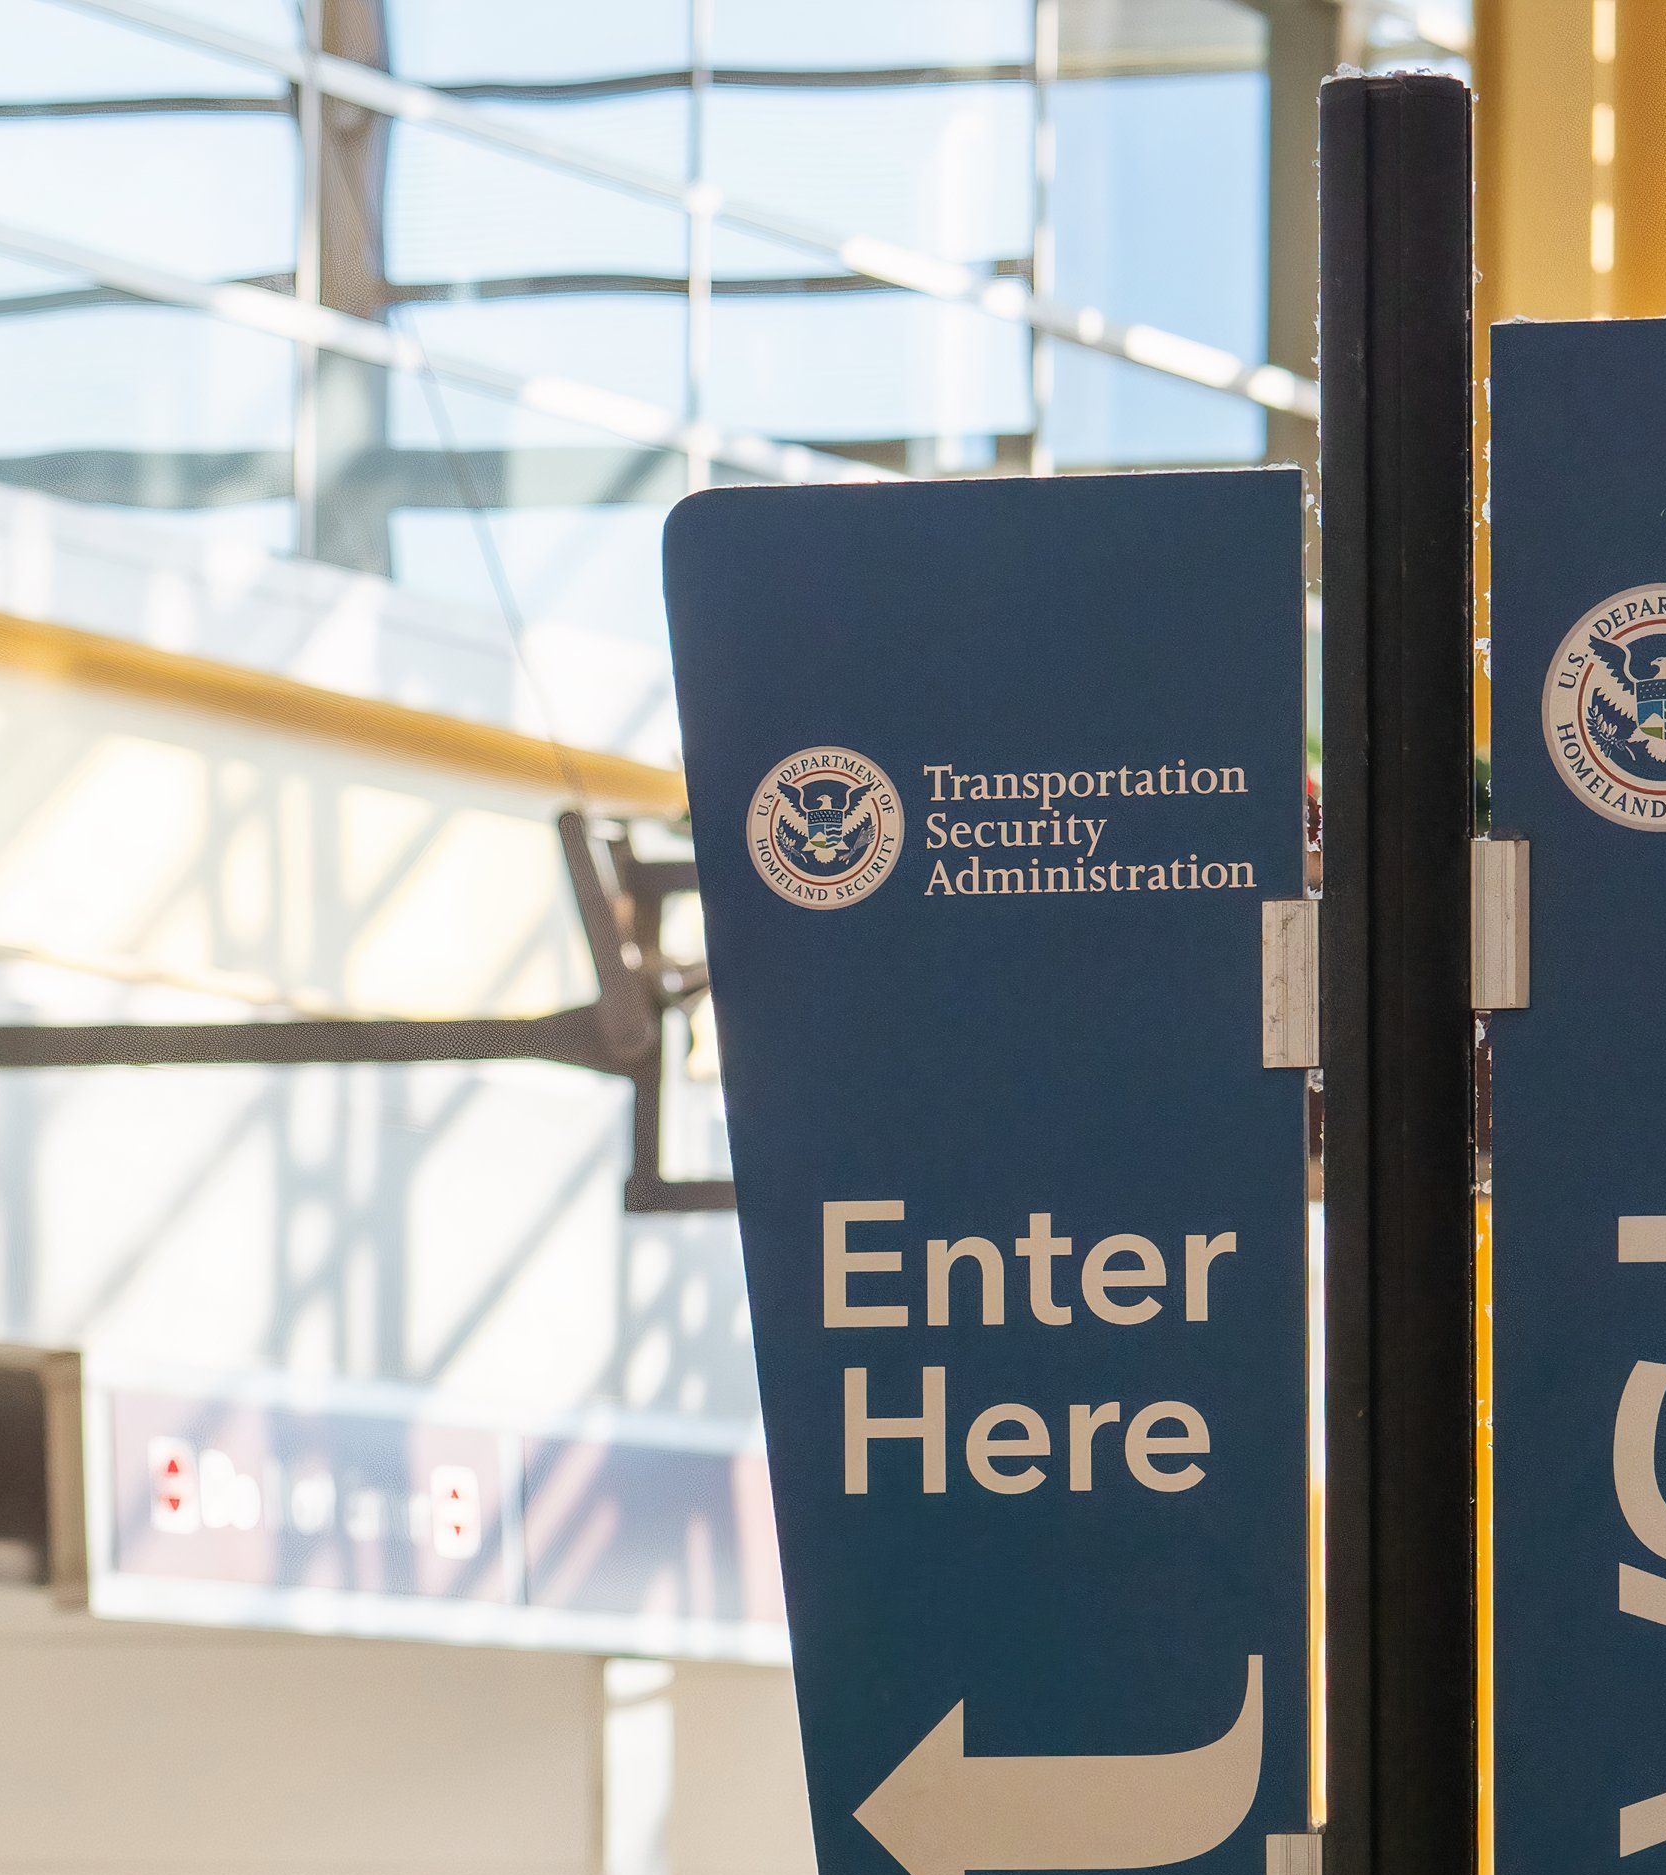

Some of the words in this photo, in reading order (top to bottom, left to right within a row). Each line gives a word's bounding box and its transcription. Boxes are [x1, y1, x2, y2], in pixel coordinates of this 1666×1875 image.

[1557, 651, 1589, 690] U.S.
[756, 791, 778, 817] U.S.
[779, 754, 885, 792] DEPARTMENT
[879, 793, 896, 815] OF
[923, 758, 1249, 810] Transportation
[925, 808, 1107, 857] Security
[756, 837, 829, 901] HOMELAND
[835, 832, 895, 900] SECURITY
[923, 853, 1257, 897] Administration
[822, 1199, 1238, 1329] Enter
[844, 1366, 1211, 1495] Here
